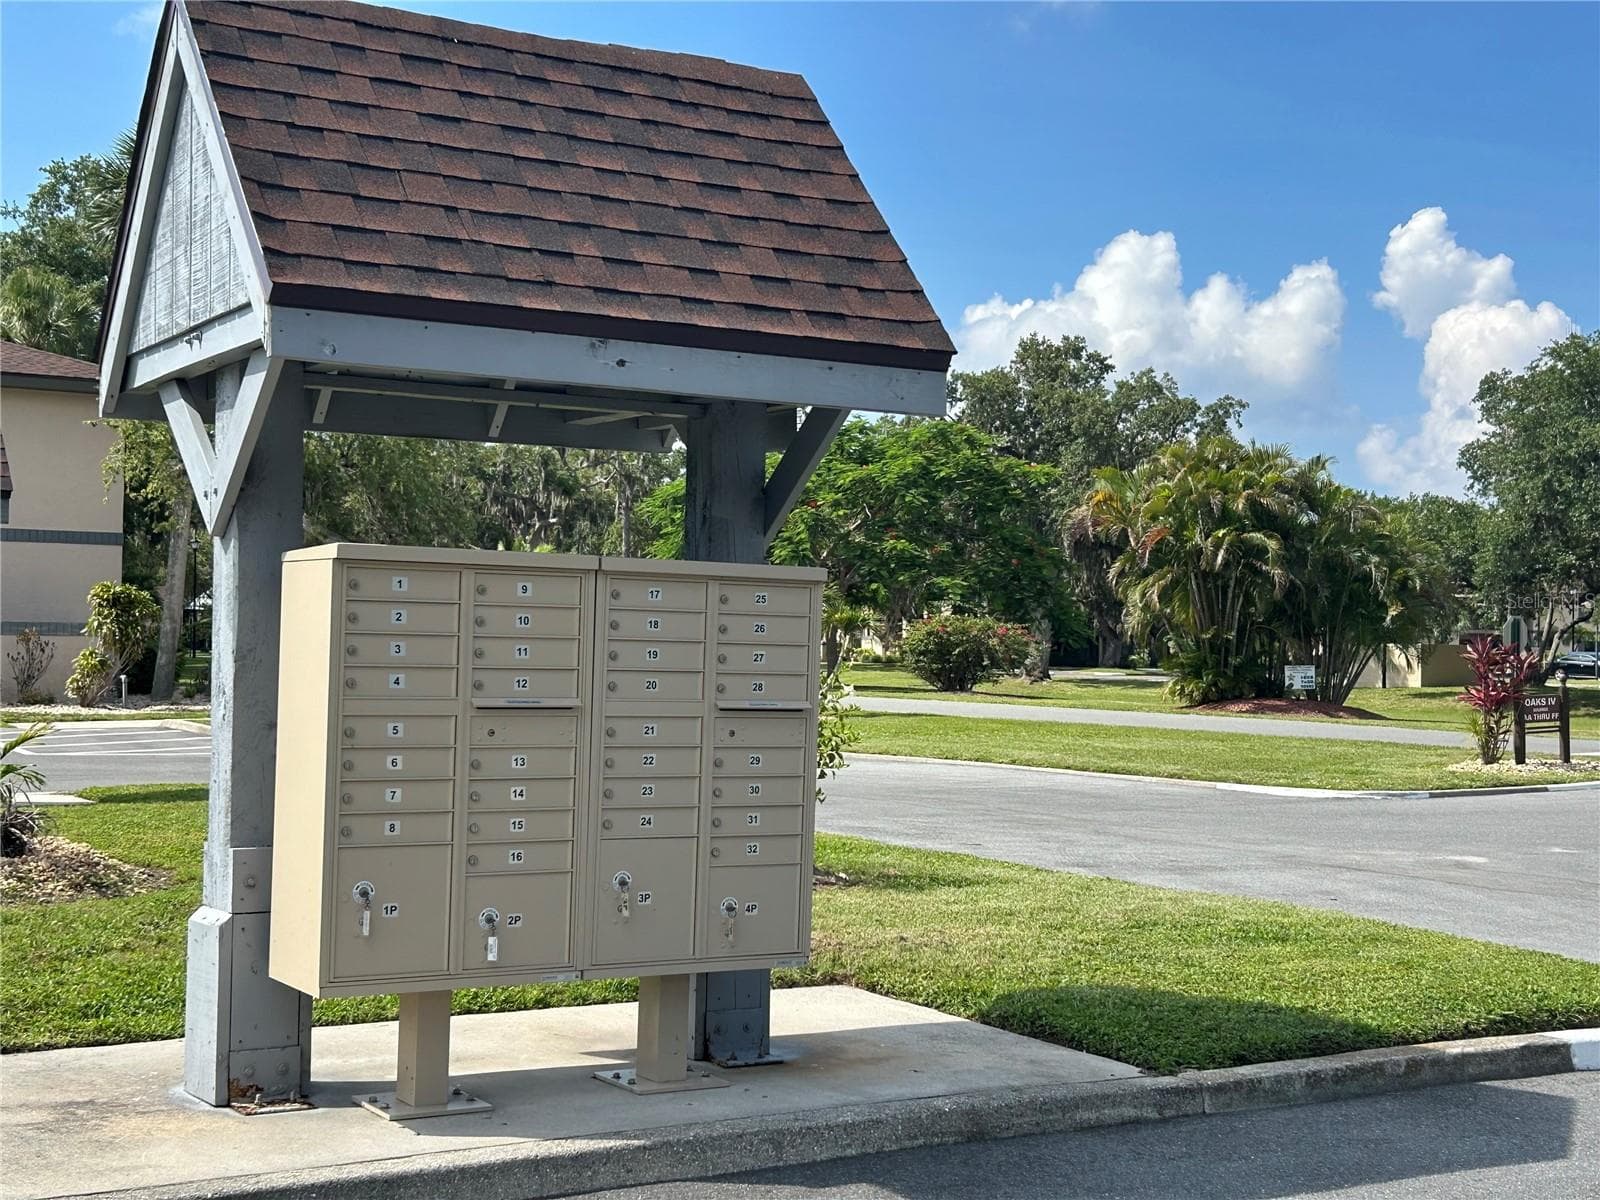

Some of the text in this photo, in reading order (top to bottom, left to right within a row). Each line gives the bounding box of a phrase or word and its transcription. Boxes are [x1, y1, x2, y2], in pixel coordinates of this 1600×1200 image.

[649, 589, 661, 599] 17
[755, 594, 767, 604] 25
[517, 615, 530, 626] 10
[647, 619, 659, 630] 18
[754, 623, 766, 633] 26
[516, 647, 528, 657] 11
[647, 649, 658, 660] 19
[753, 653, 765, 663] 27
[515, 678, 528, 689] 12
[645, 680, 657, 690] 20
[752, 682, 764, 692] 28
[1524, 697, 1557, 707] OAKS IV
[1533, 712, 1551, 721] THRU
[643, 725, 655, 735] 21
[513, 757, 526, 767] 13
[642, 756, 655, 766] 22
[749, 755, 761, 766] 29
[512, 788, 524, 799] 14
[641, 786, 654, 796] 23
[749, 785, 760, 795] 30
[511, 820, 524, 830] 15
[640, 816, 652, 826] 24
[747, 815, 759, 825] 31
[746, 844, 759, 855] 32
[510, 851, 523, 862] 16
[638, 893, 651, 904] 3P
[383, 905, 398, 916] 1P
[745, 903, 758, 914] 4P
[507, 915, 522, 926] 2P
